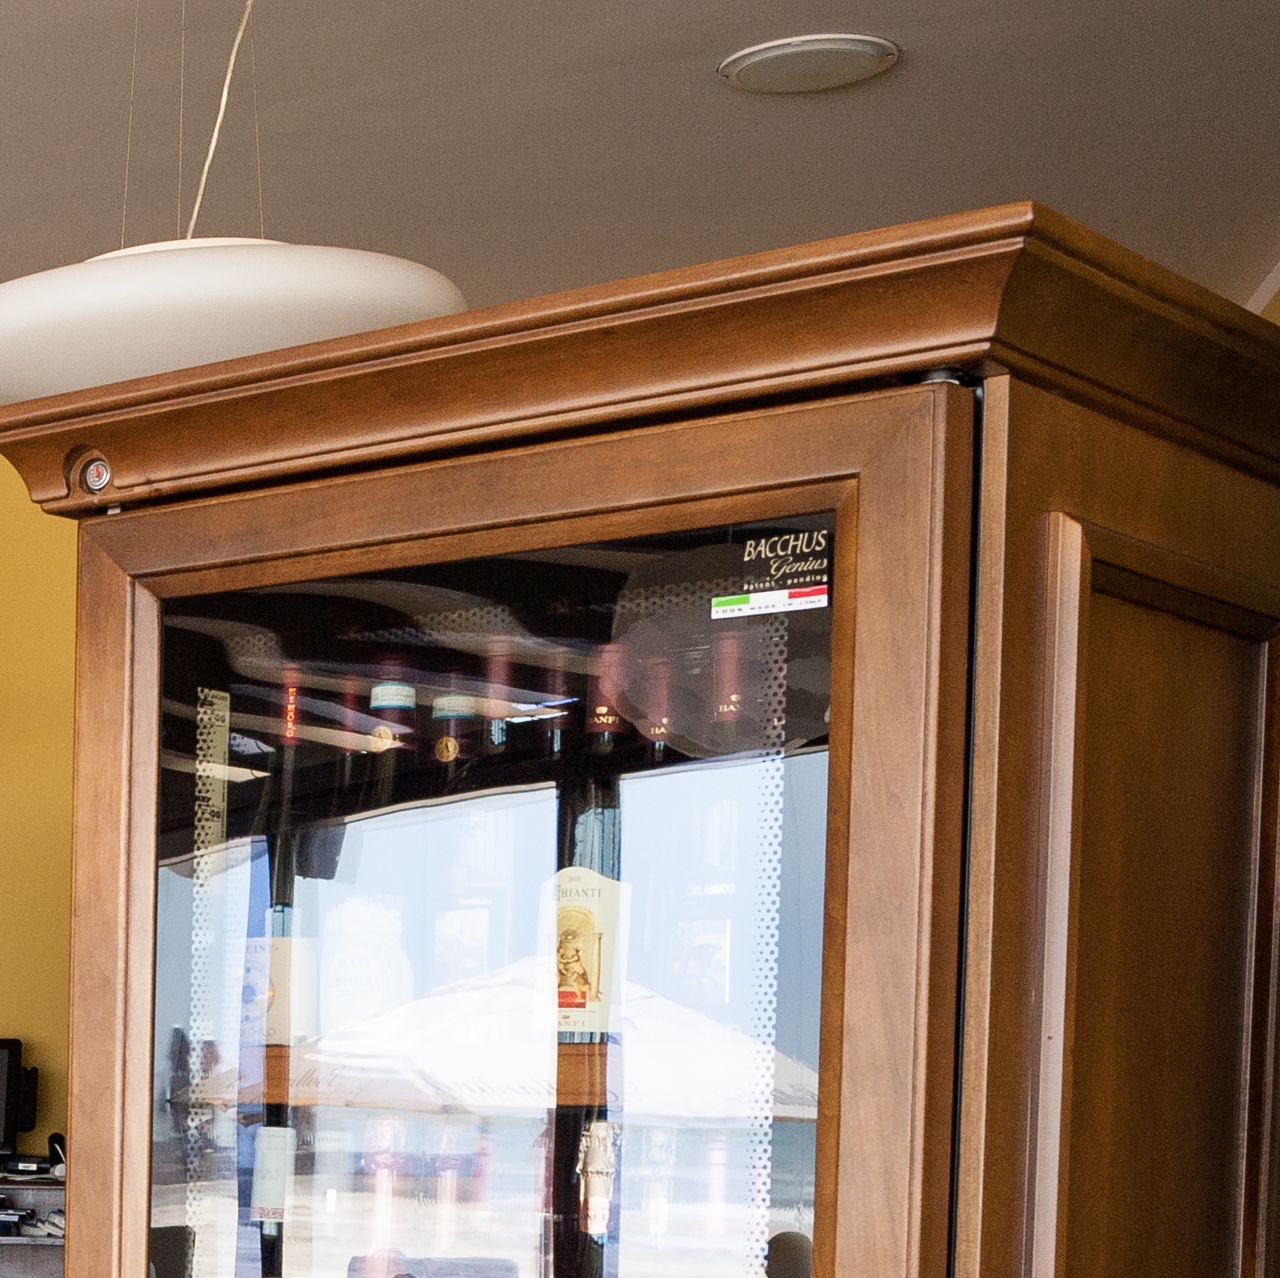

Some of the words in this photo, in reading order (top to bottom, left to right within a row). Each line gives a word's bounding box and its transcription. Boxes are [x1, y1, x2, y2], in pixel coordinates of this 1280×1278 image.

[743, 530, 828, 562] BACCHUS
[770, 556, 828, 580] Genius
[743, 577, 776, 591] Patent
[787, 574, 828, 587] pending
